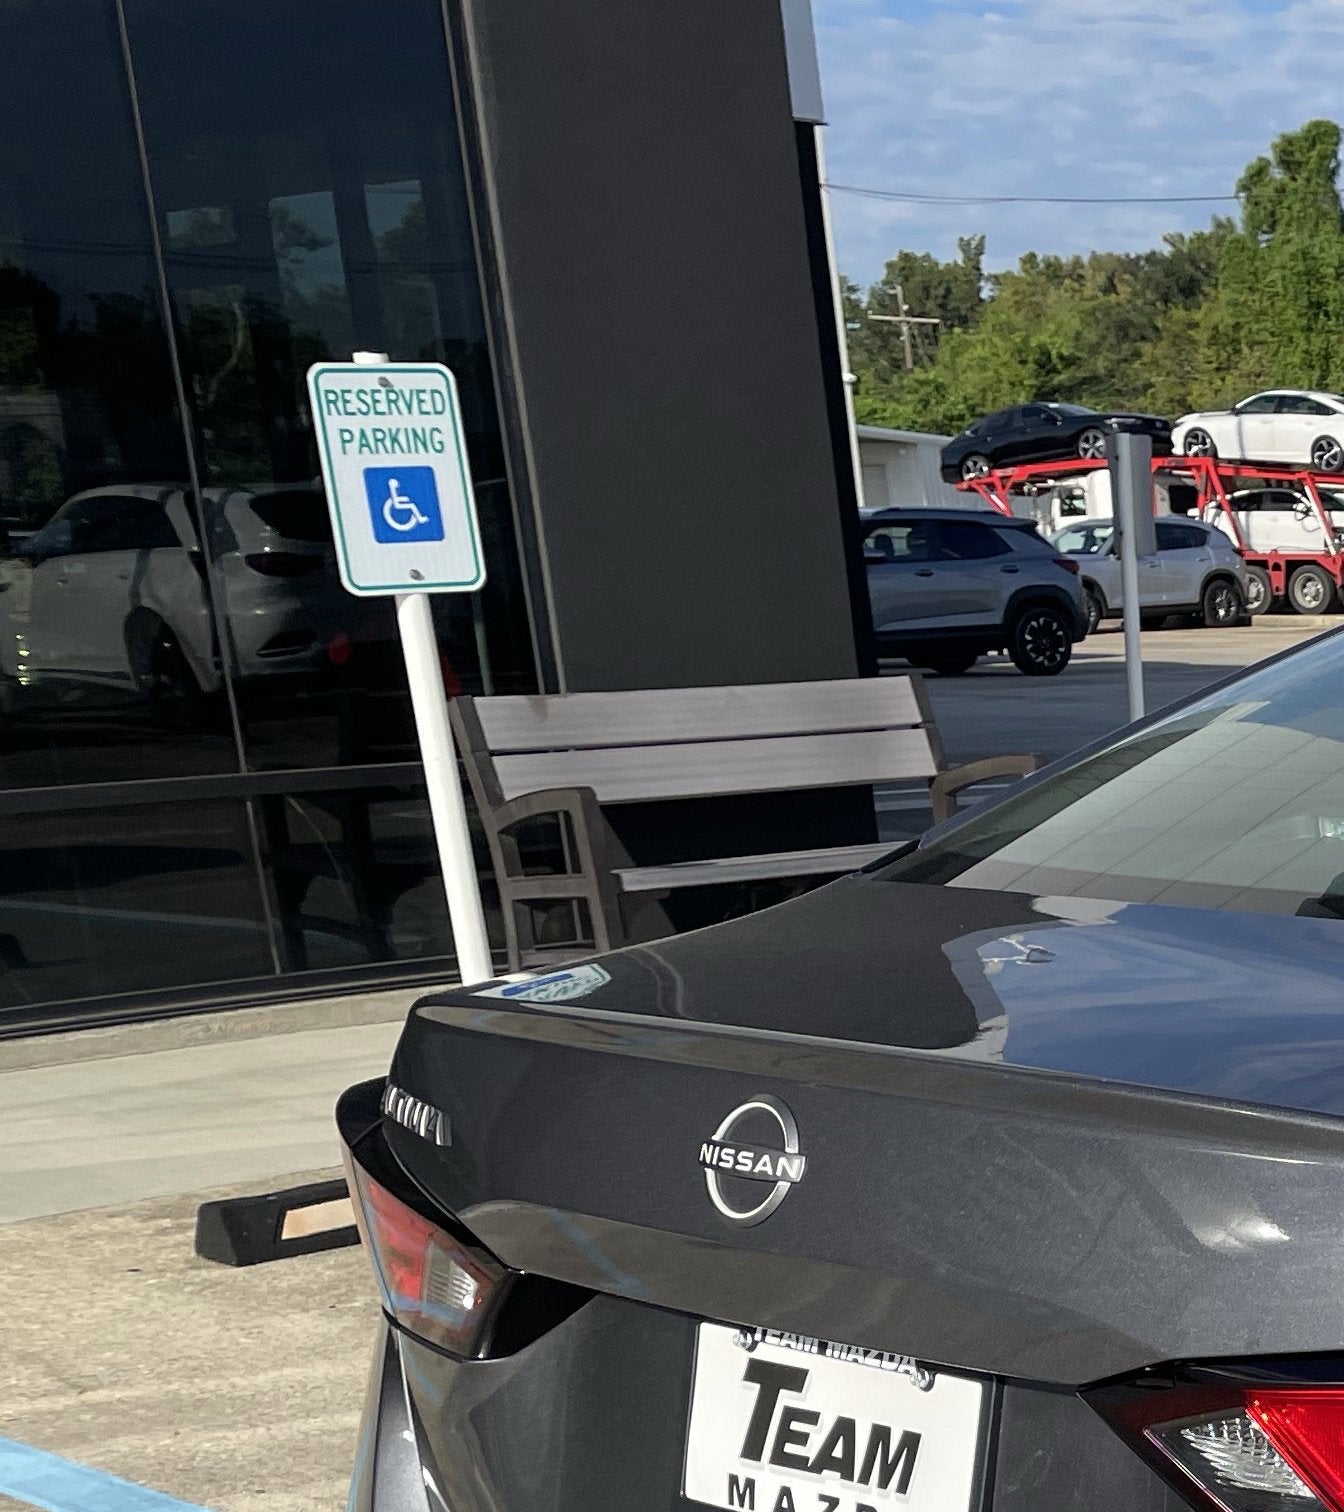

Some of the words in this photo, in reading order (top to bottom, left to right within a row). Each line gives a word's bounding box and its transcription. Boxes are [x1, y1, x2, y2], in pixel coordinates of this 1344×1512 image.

[323, 389, 446, 416] RESERVED
[338, 427, 445, 455] PARKING
[699, 1142, 801, 1179] NISSAN
[741, 1357, 922, 1497] TEAM
